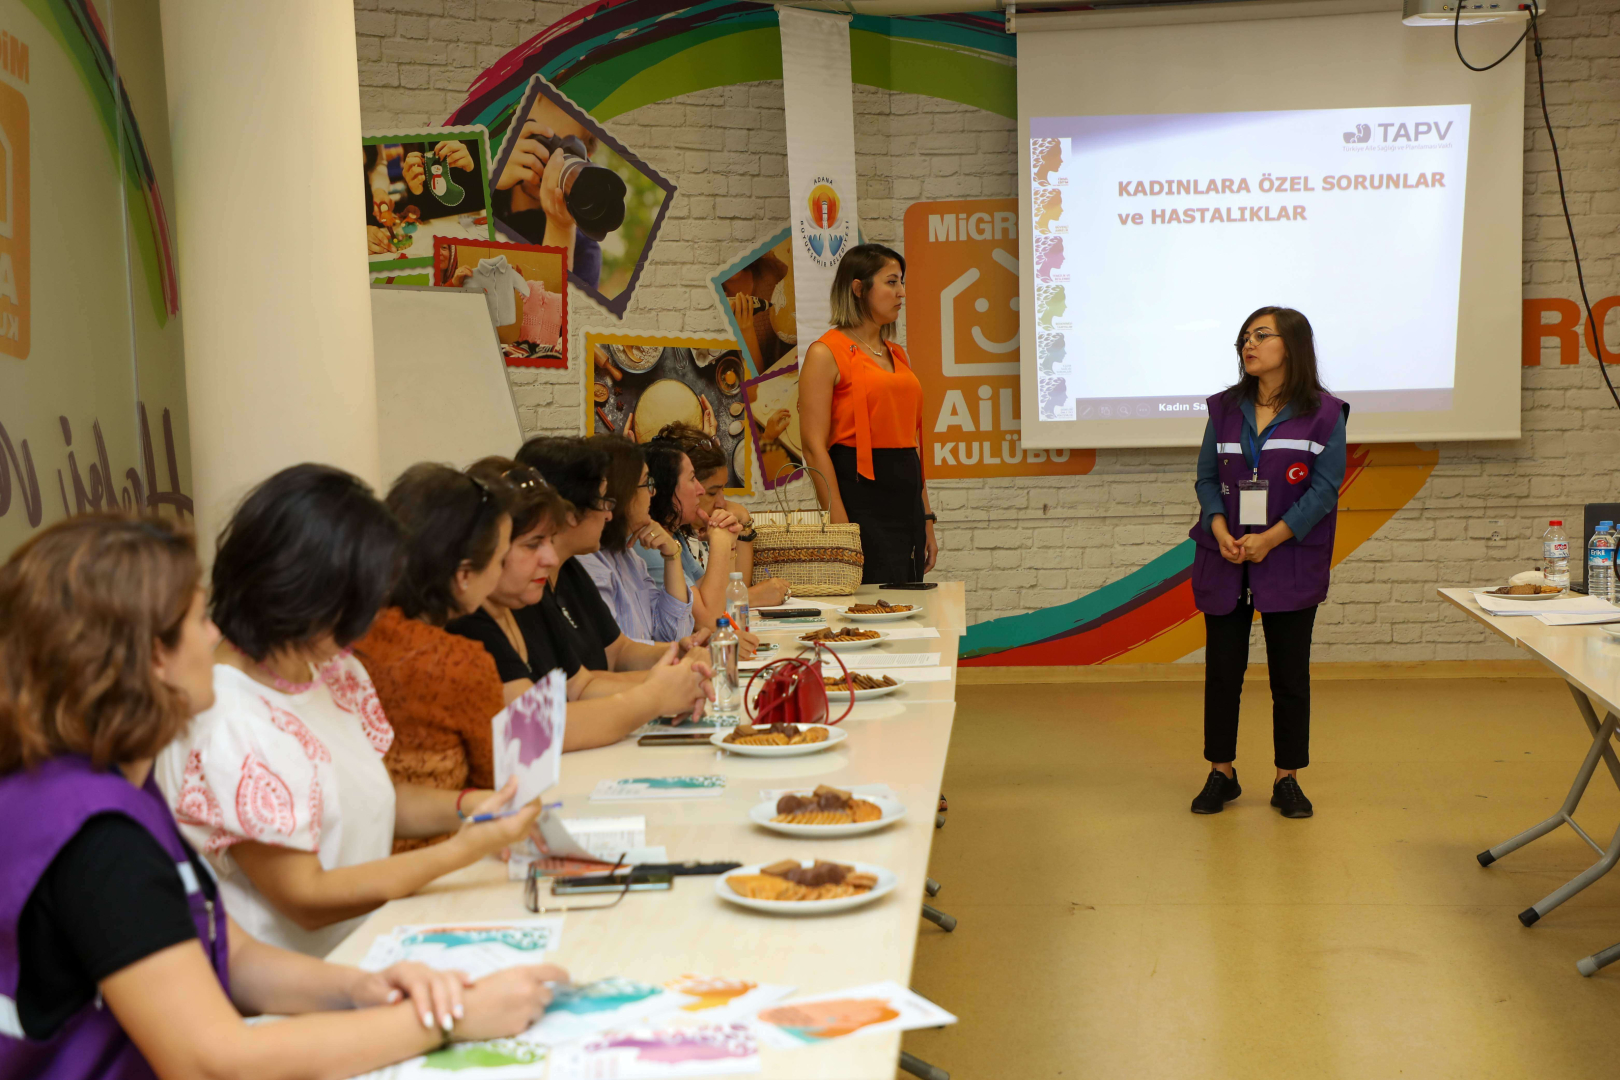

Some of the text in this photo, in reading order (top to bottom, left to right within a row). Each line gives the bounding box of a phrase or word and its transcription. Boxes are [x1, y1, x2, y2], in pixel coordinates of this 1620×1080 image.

[1377, 120, 1454, 143] TAPV
[1343, 145, 1364, 153] Türkiye
[813, 176, 833, 186] ADANA
[1117, 172, 1446, 197] KADINLARA ÖZEL SORUNLAR
[1117, 204, 1308, 226] ve HASTALIKLAR
[928, 211, 1018, 242] MiGR
[933, 384, 1021, 433] AiL
[1158, 402, 1209, 413] Kadın Sa
